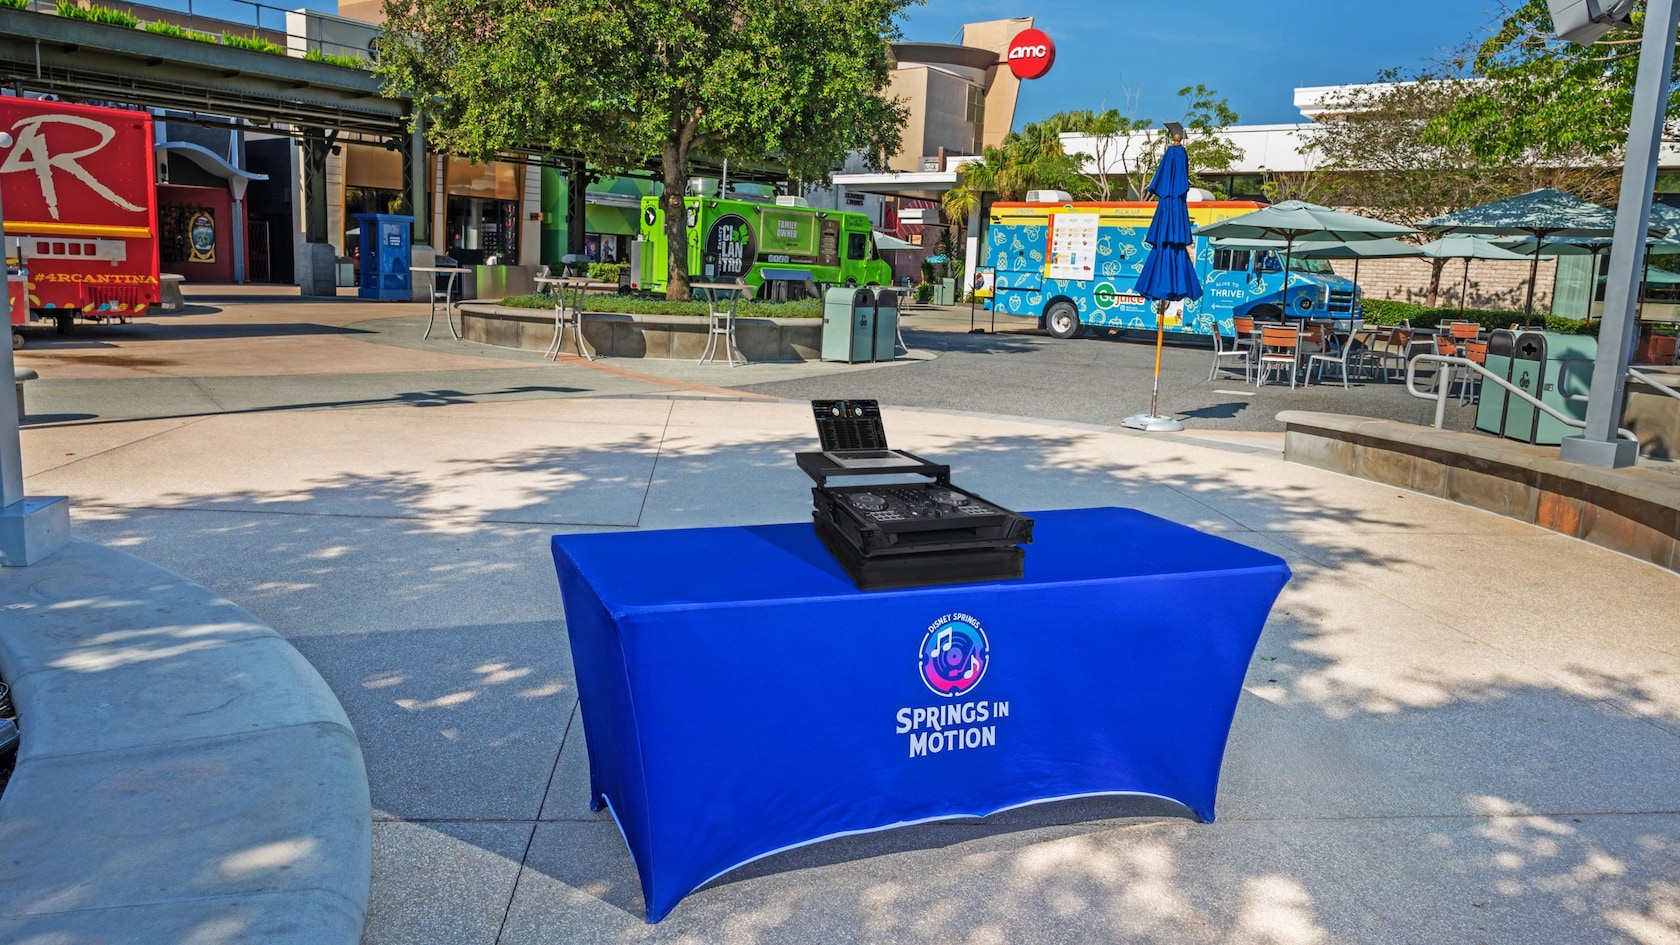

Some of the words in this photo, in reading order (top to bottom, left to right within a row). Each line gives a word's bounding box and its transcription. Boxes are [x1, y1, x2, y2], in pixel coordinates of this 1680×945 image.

[777, 220, 797, 229] FAMILY
[776, 229, 797, 238] OWNED
[722, 241, 743, 258] LAN
[721, 257, 743, 273] TRO
[34, 272, 159, 284] #4RCANTINA
[1210, 288, 1245, 298] THRIVE!
[928, 613, 952, 633] DISNEY
[953, 612, 981, 629] SPRINGS
[896, 701, 990, 734] SPRINGS
[993, 701, 1009, 718] IN
[909, 726, 996, 758] MOTION
